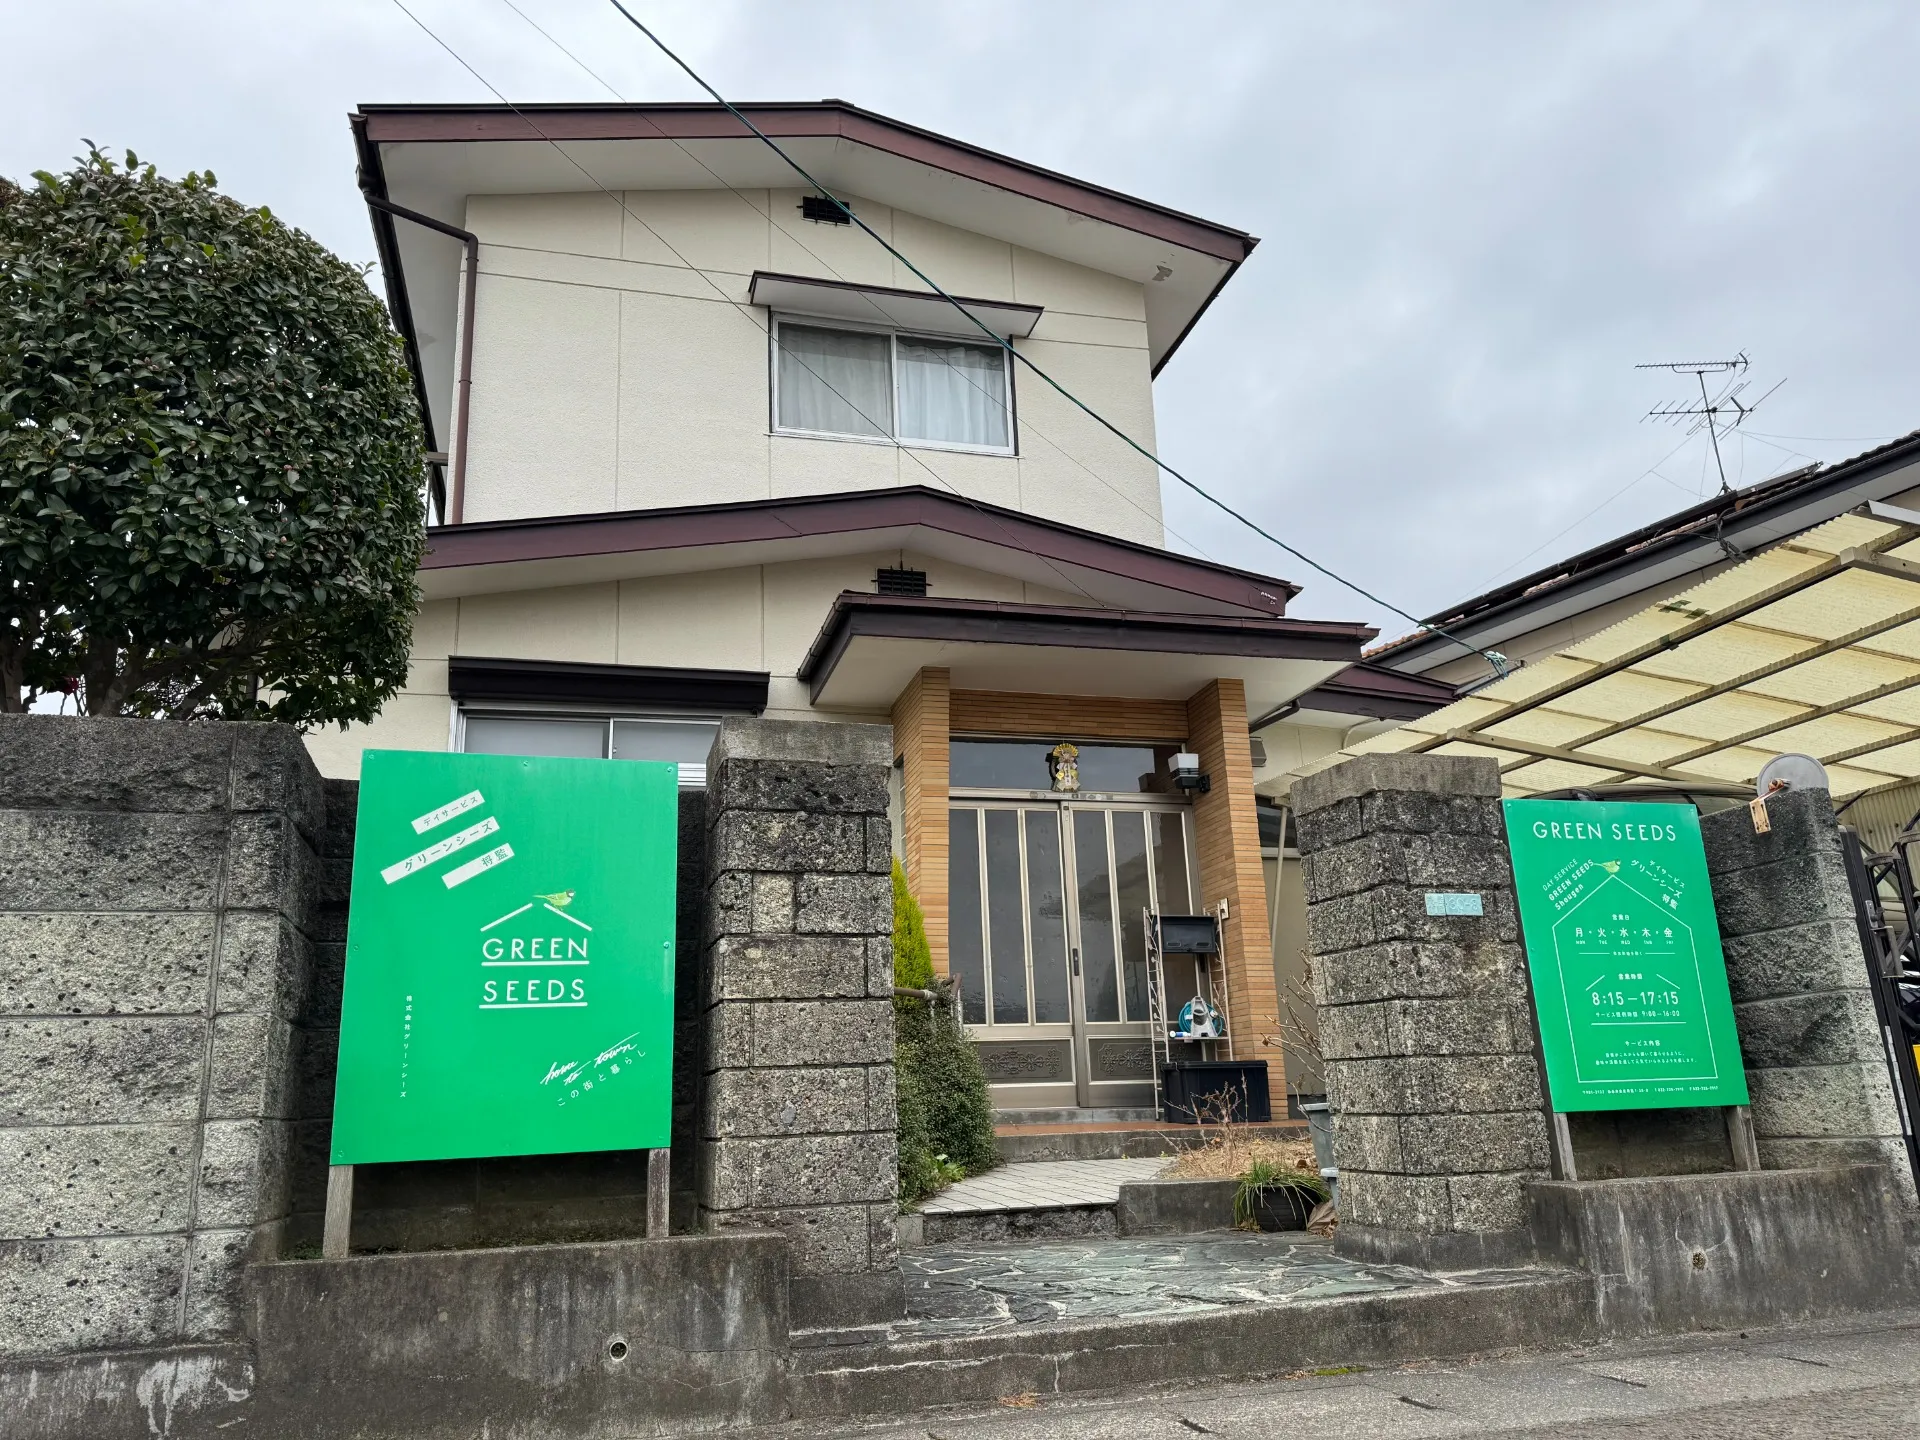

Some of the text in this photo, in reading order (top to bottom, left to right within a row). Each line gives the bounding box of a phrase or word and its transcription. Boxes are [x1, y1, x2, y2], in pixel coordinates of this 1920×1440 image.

[424, 796, 478, 826] デイサービス
[404, 820, 493, 872] グリーンシーズ
[1532, 821, 1677, 842] GREEN SEEDS
[481, 848, 509, 867] 将監
[1542, 858, 1579, 891] DAY SERVICE
[1548, 858, 1595, 902] GREEN SEEDS
[1630, 859, 1683, 899] グリーンシーズ
[1649, 859, 1686, 889] デイサービス
[1554, 883, 1585, 911] Shougen
[1575, 927, 1674, 938] 月・火・水・木・金
[482, 937, 589, 961] GREEN
[482, 978, 586, 1003] SEEDS
[540, 1061, 579, 1086] home
[594, 1031, 641, 1069] town
